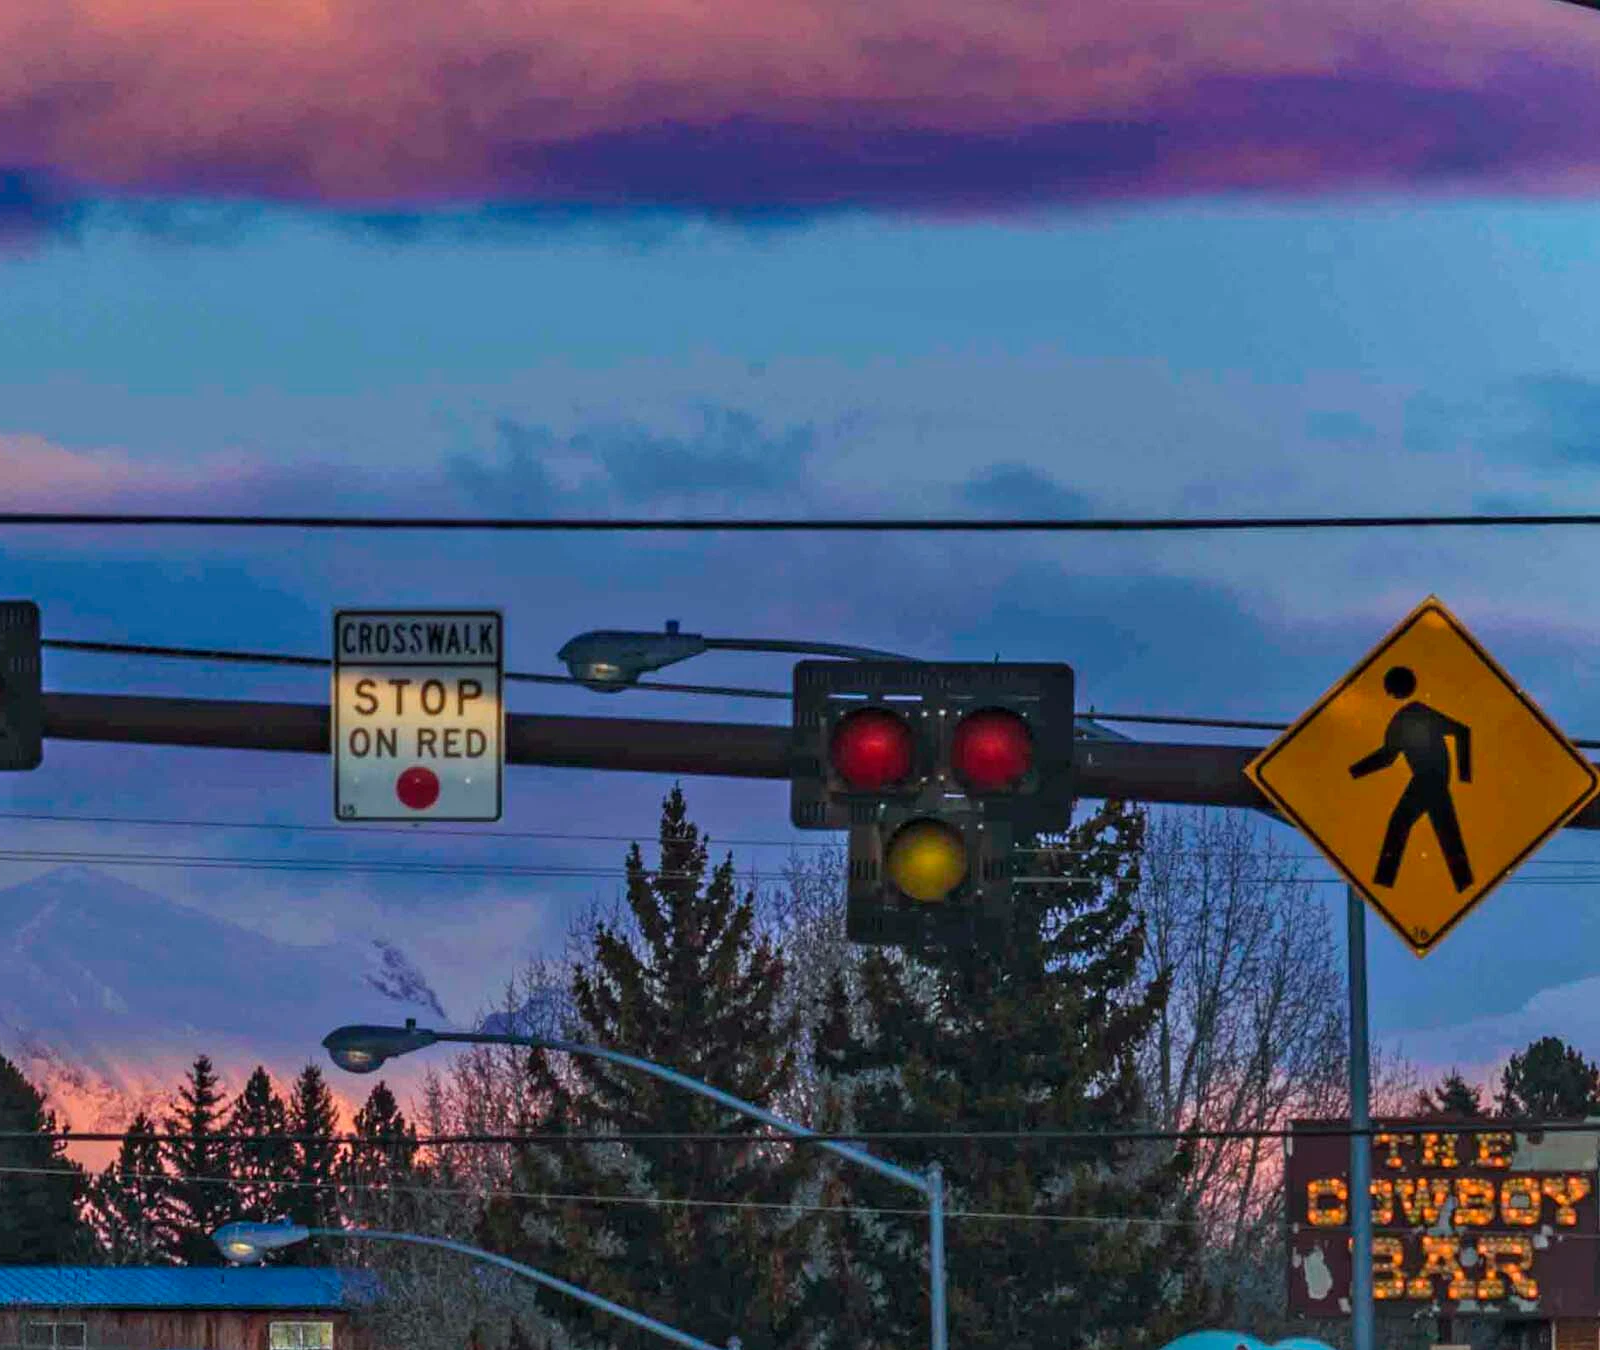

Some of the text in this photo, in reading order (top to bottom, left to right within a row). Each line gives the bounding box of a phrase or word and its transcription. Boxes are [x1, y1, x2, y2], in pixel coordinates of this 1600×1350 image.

[342, 622, 494, 655] CROSSWALK
[354, 678, 483, 716] STOP
[350, 727, 488, 758] ON RED
[1373, 1131, 1514, 1169] THE
[1306, 1176, 1592, 1227] COWBOY
[1348, 1236, 1539, 1300] BAR
